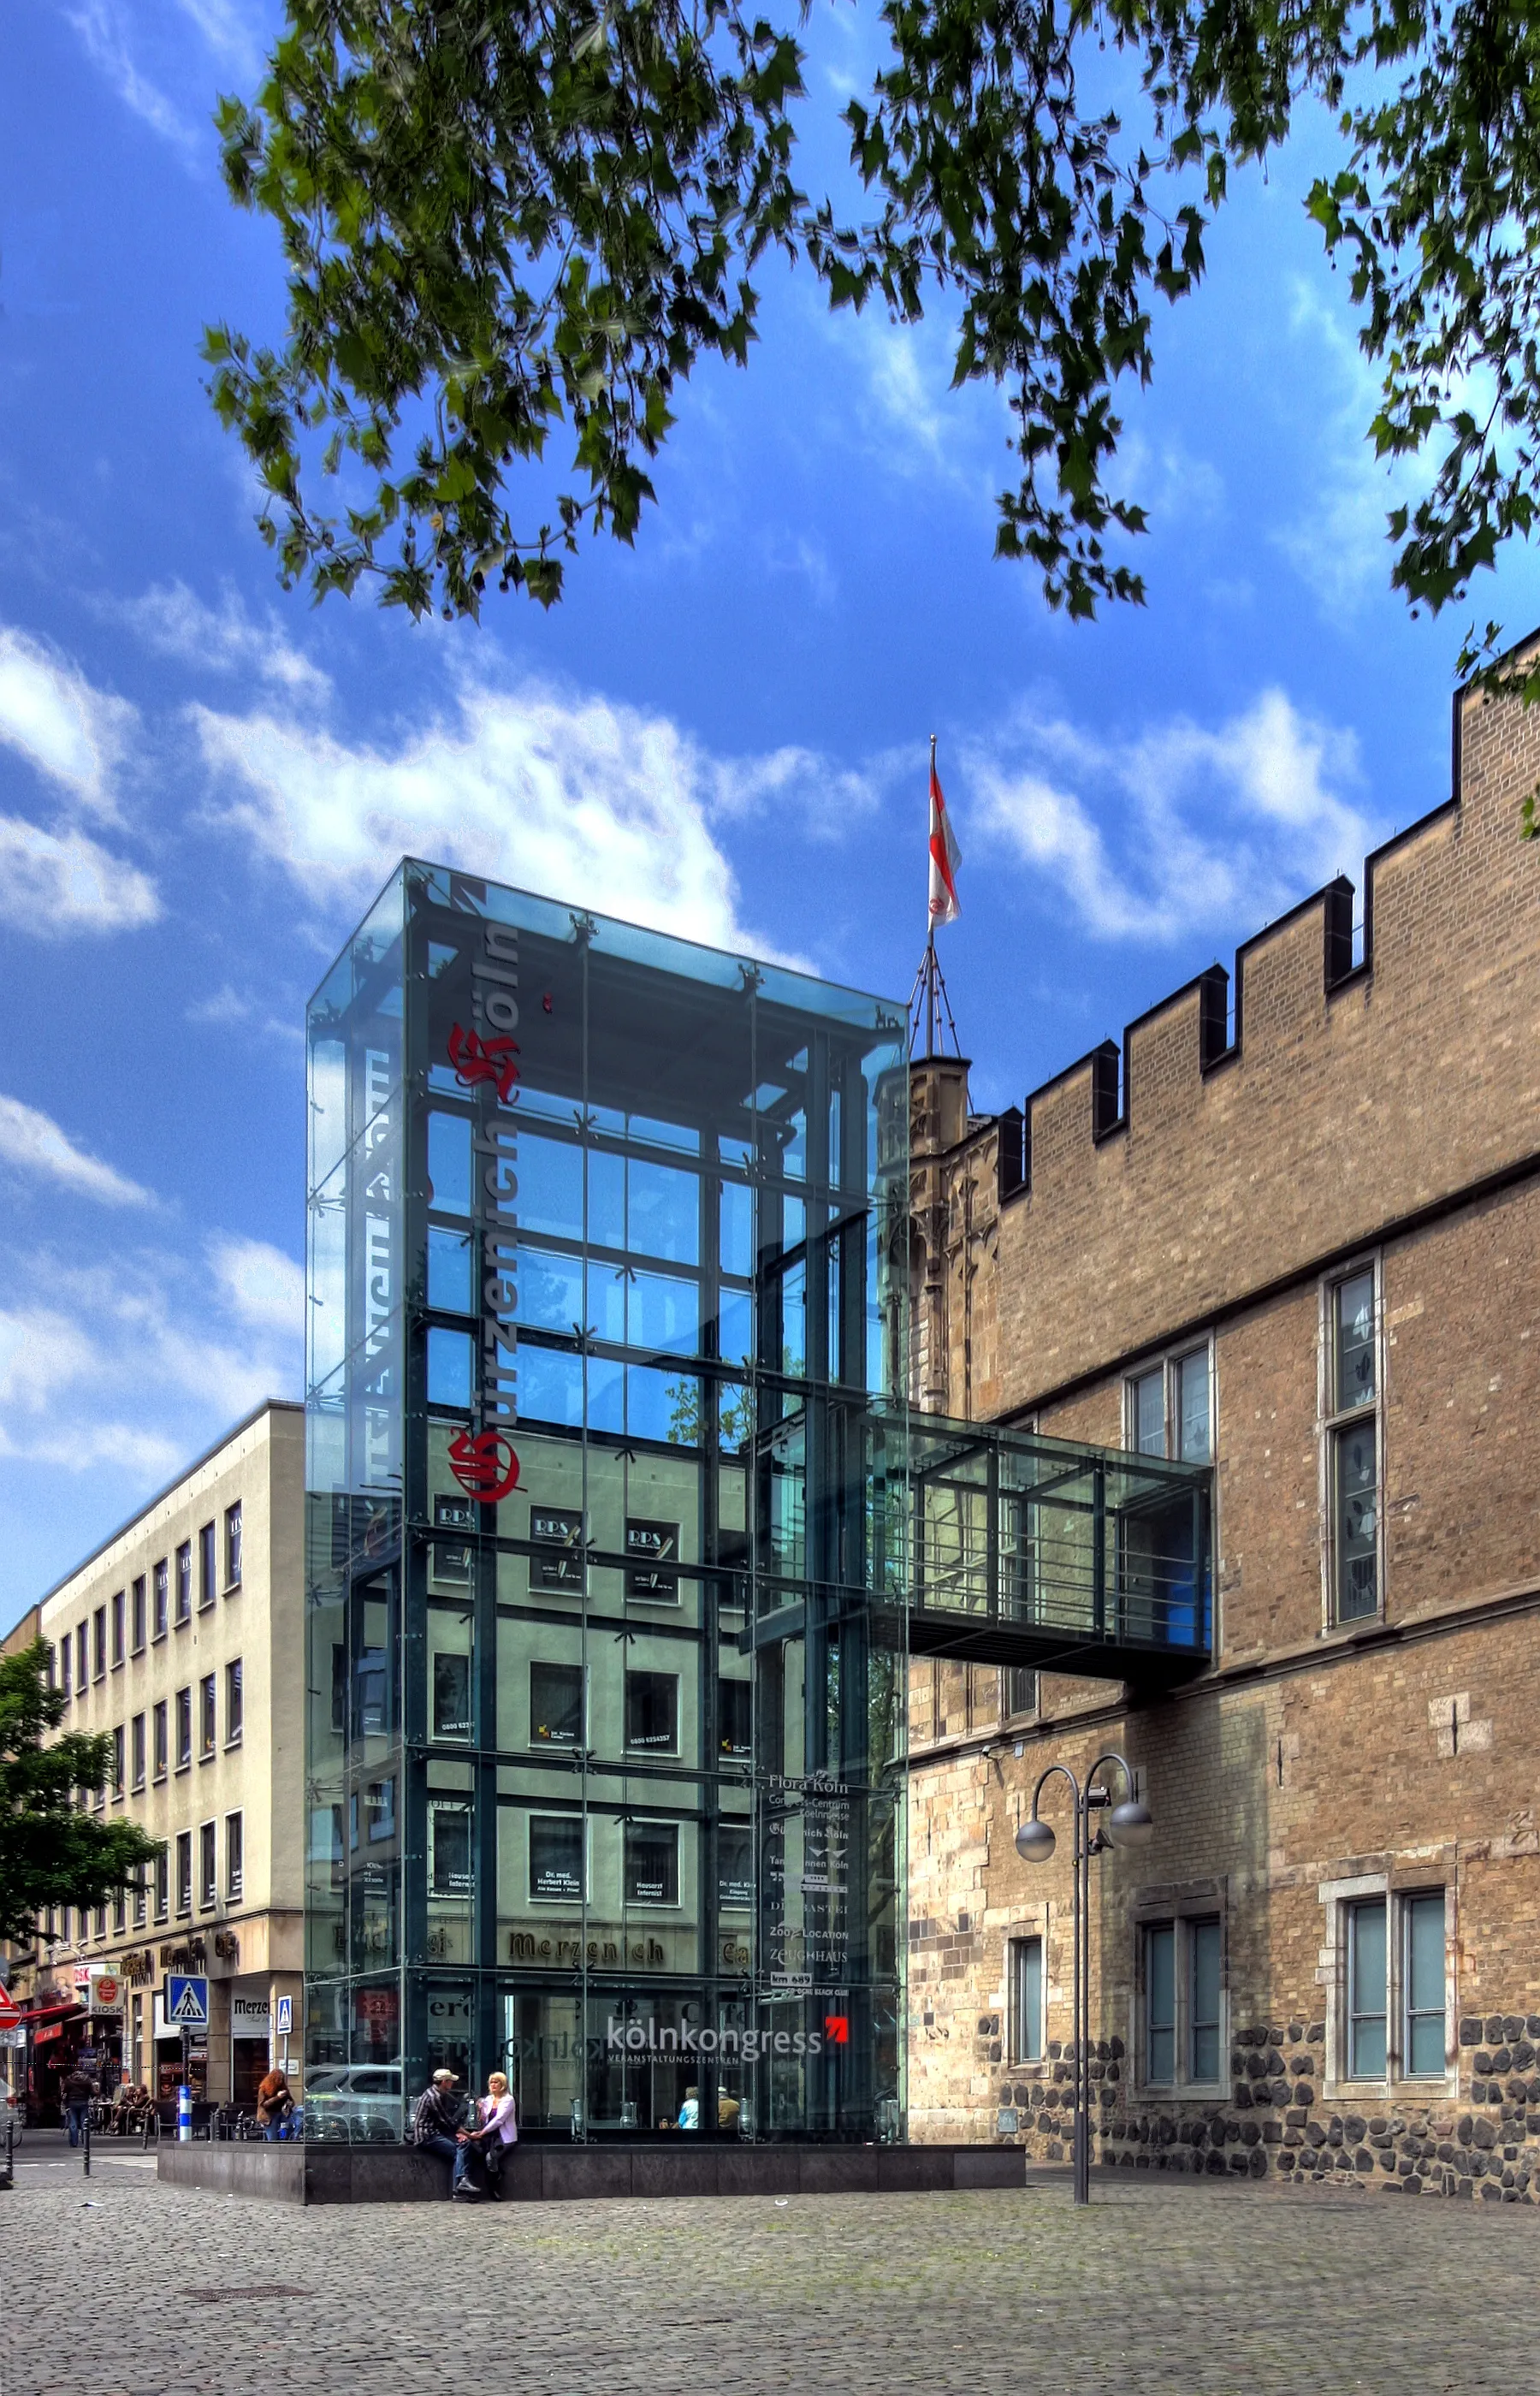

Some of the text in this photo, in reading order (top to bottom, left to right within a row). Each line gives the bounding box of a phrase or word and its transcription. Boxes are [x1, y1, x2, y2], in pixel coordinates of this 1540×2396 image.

[445, 921, 520, 1105] Köln
[447, 1119, 529, 1504] Gürzenich
[534, 1519, 569, 1534] RPS
[628, 1529, 661, 1545] RPS
[770, 1775, 808, 1790] Flora
[508, 1931, 665, 1963] Merzenich
[772, 1974, 788, 1984] km
[607, 2016, 822, 2062] kölnkongress
